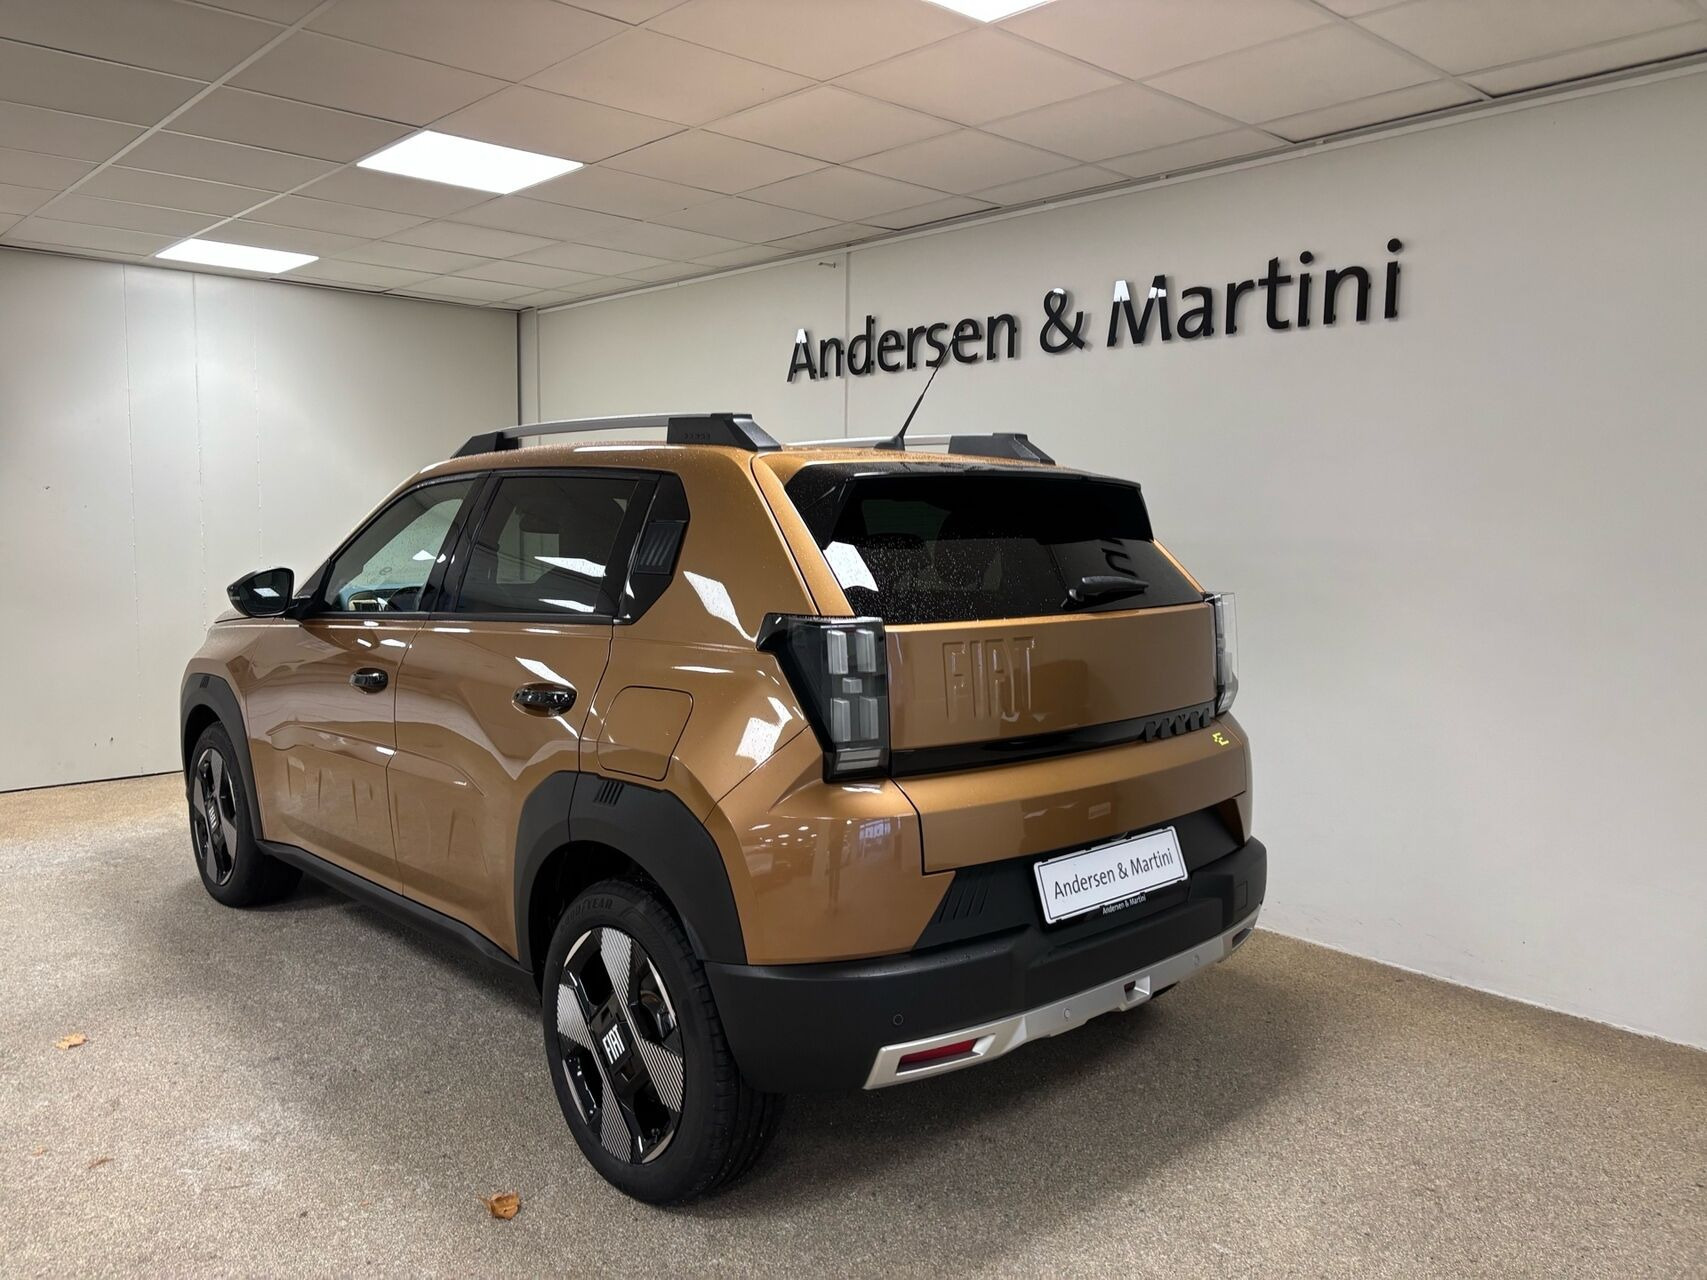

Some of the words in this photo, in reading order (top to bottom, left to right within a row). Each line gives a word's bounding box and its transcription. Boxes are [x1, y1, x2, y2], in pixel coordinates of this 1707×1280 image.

[786, 312, 1018, 383] Andersen
[1039, 287, 1086, 354] &
[1106, 238, 1403, 348] Martini
[942, 636, 1034, 721] FIAT
[1054, 868, 1116, 899] Andersen
[1118, 862, 1129, 880] &
[1130, 848, 1174, 876] Martini
[1102, 902, 1124, 915] Andersen
[1129, 893, 1147, 906] Martini
[602, 1023, 626, 1065] FIAT
